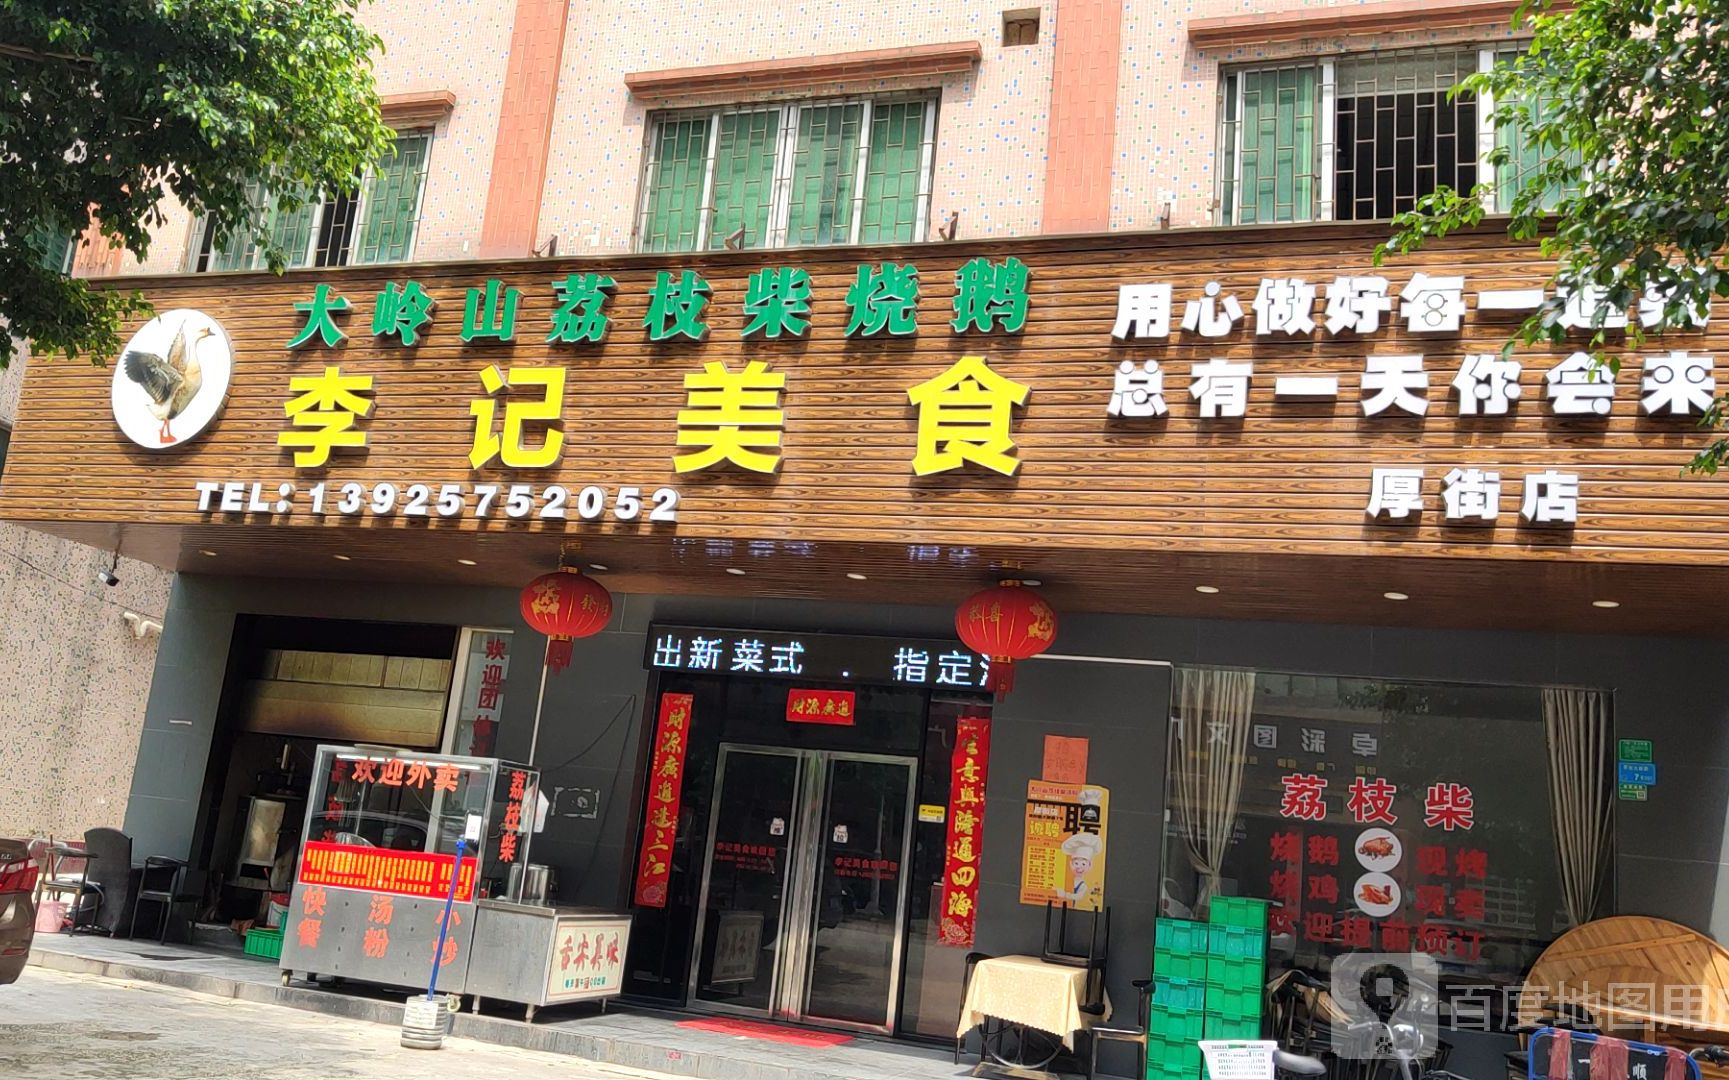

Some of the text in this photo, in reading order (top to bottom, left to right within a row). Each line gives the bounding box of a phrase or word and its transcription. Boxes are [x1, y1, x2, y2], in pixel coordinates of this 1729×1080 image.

[287, 257, 1032, 347] 大岭山荔枝柴烧鹅
[1110, 265, 1712, 339] 用心做好每一道
[277, 355, 1033, 477] 李记美食
[1106, 350, 1716, 419] 总有一天你会来
[1364, 468, 1580, 523] 厚街店
[653, 633, 805, 675] 出新菜式
[351, 756, 460, 793] 欢迎外卖
[1279, 772, 1475, 832] 荔枝柴
[499, 770, 527, 863] 荔枝柴
[297, 886, 327, 949] 快餐
[363, 894, 393, 959] 汤粉
